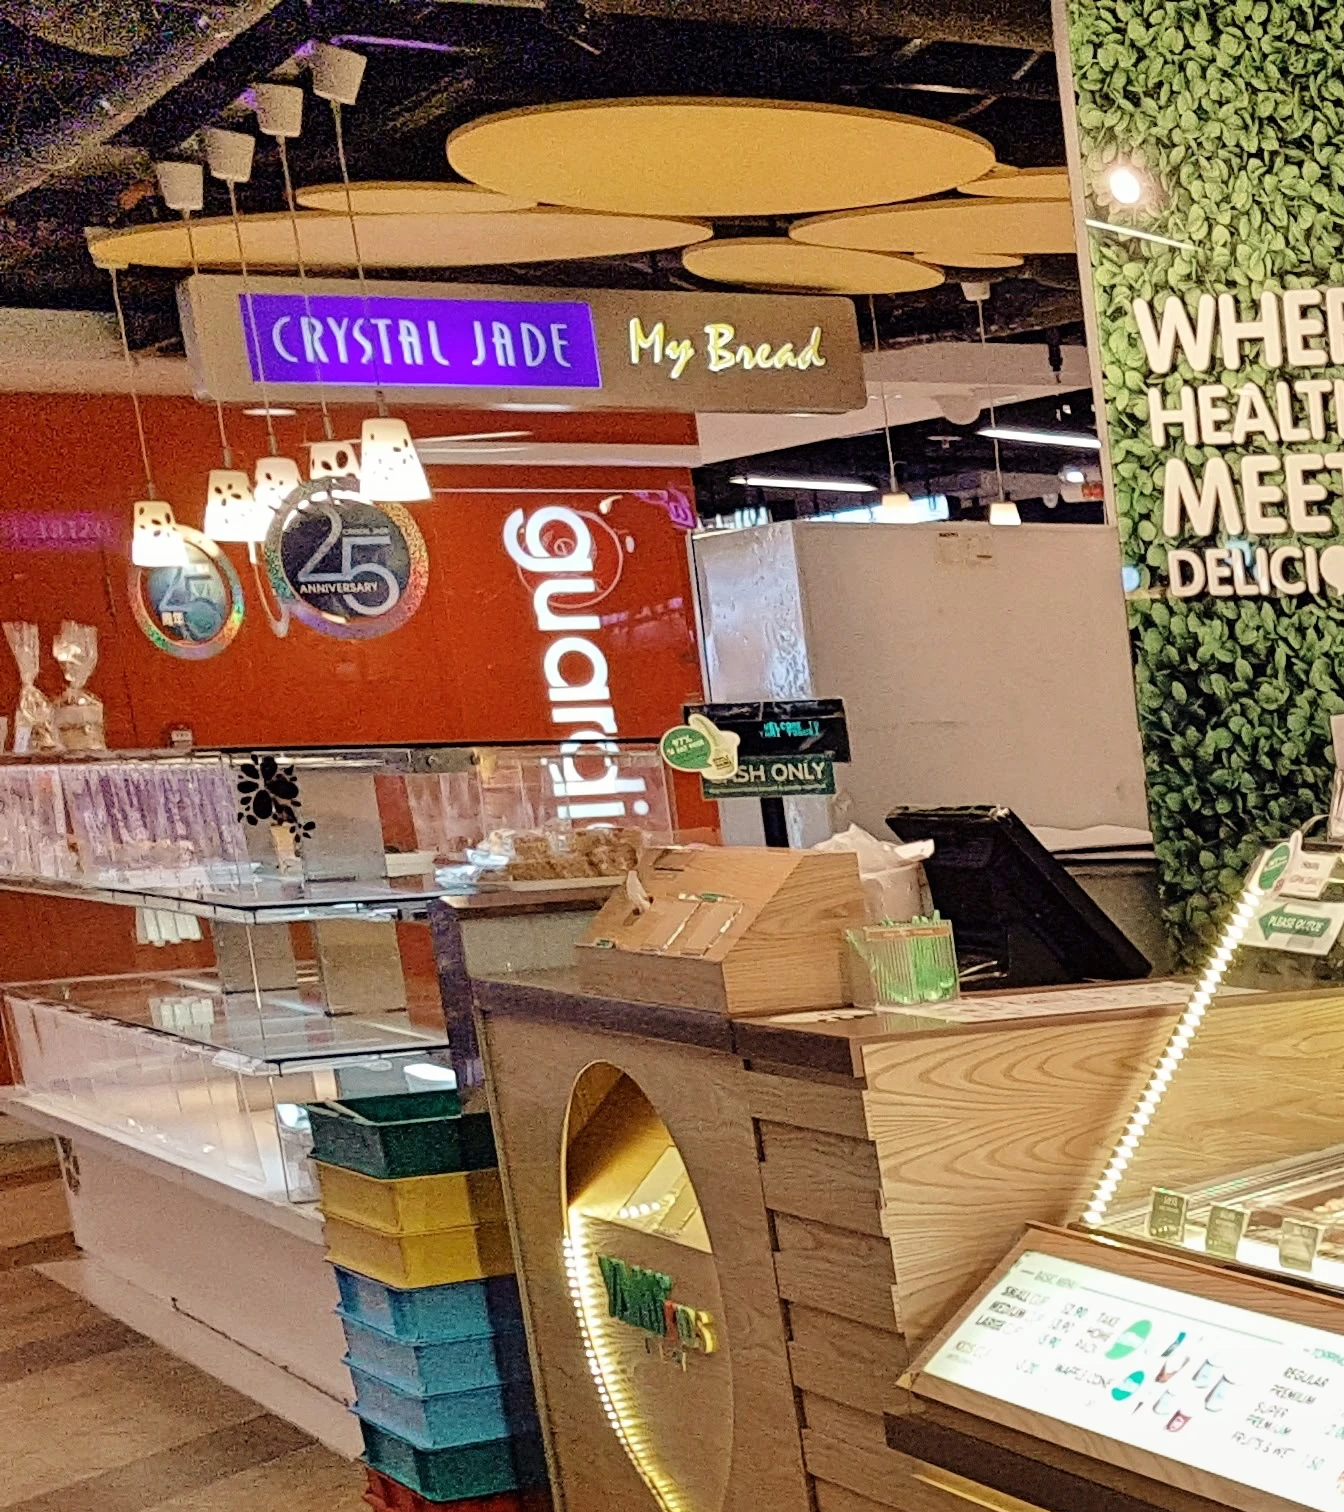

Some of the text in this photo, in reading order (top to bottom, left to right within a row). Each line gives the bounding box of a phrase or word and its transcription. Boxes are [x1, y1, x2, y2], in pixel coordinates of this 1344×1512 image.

[271, 314, 571, 369] CRYSTAL JADE
[627, 316, 826, 379] My Bread
[300, 581, 379, 595] ANNIVERSARY
[503, 506, 650, 830] guardi
[771, 761, 826, 781] ONLY
